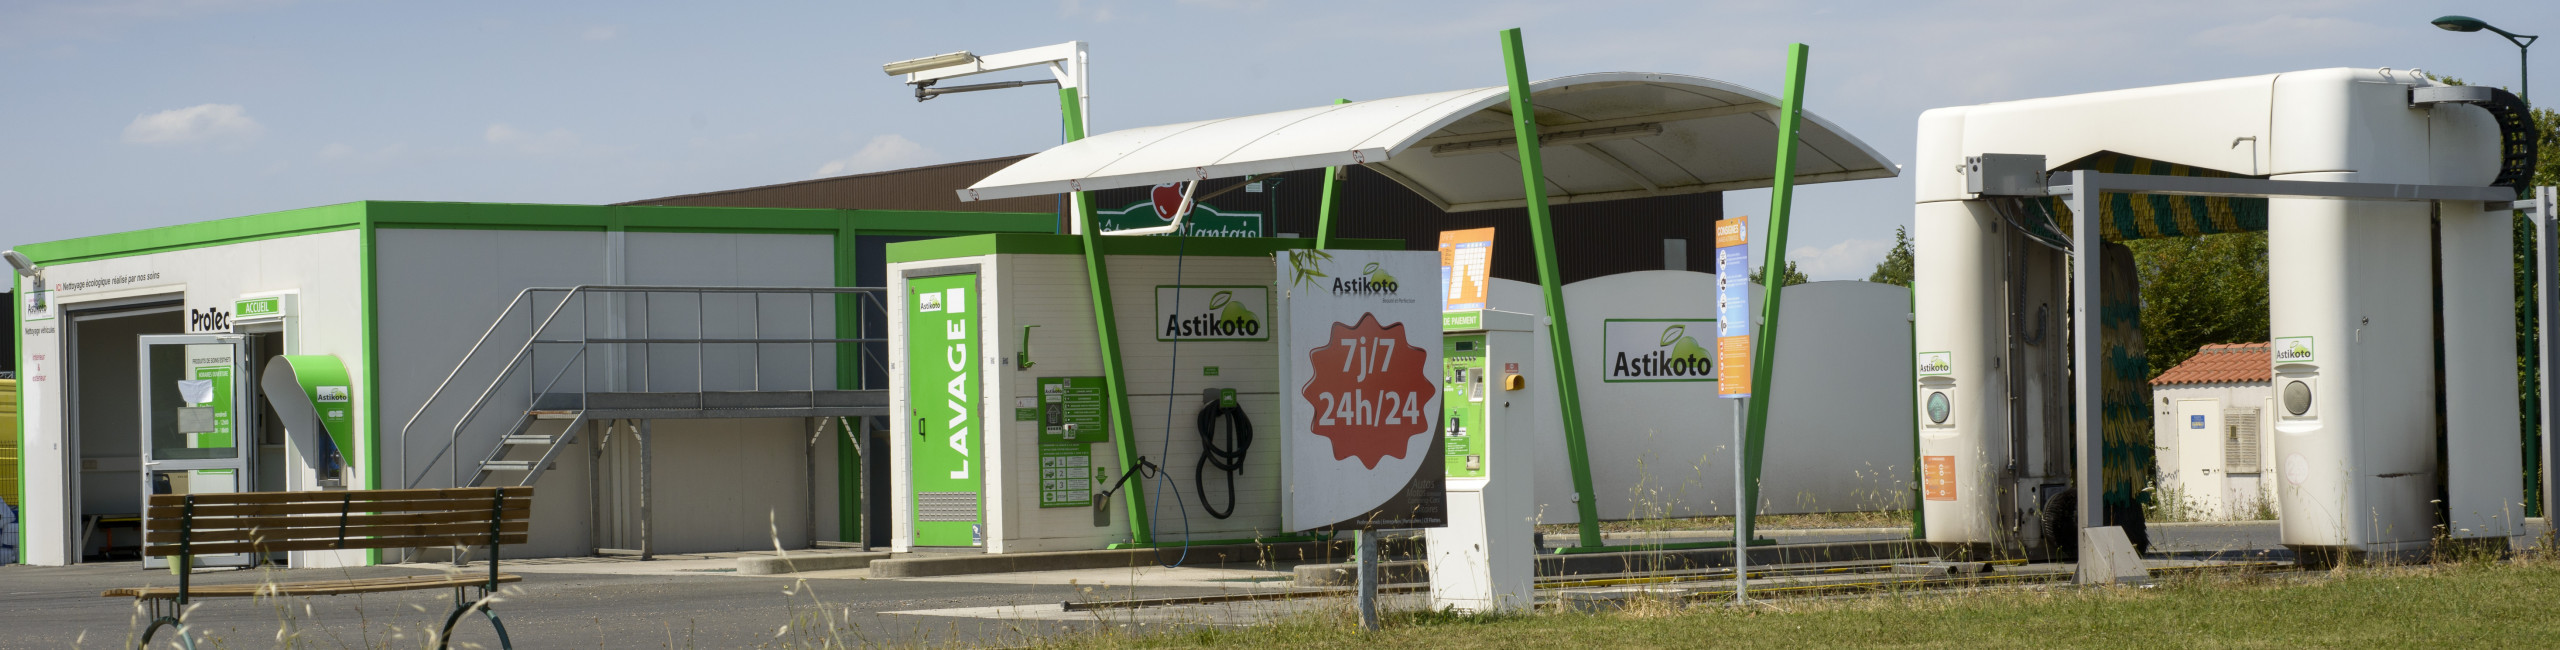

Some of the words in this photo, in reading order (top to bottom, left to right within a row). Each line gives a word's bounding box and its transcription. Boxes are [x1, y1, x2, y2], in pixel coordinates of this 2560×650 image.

[1717, 224, 1739, 236] CONSIGNES
[62, 280, 85, 291] Nettoyage
[85, 277, 110, 288] écologique
[112, 275, 128, 285] réalisé
[128, 275, 136, 284] par
[137, 273, 146, 282] nos
[147, 271, 160, 280] soins
[1332, 276, 1398, 293] Astikoto
[245, 301, 269, 314] ACCUEIL
[920, 302, 941, 310] Astikoto
[1165, 313, 1259, 337] Astikoto
[1443, 317, 1450, 325] DE
[1451, 316, 1477, 325] PAIEMENT
[25, 327, 40, 336] Nettoyage
[1341, 336, 1396, 383] 7j/7
[2276, 349, 2311, 359] Astikoto
[1613, 350, 1711, 377] Astikoto
[1920, 363, 1949, 372] Astikoto
[946, 319, 969, 480] LAVAGE
[1318, 388, 1420, 427] 24h/24
[1411, 479, 1435, 489] Autos
